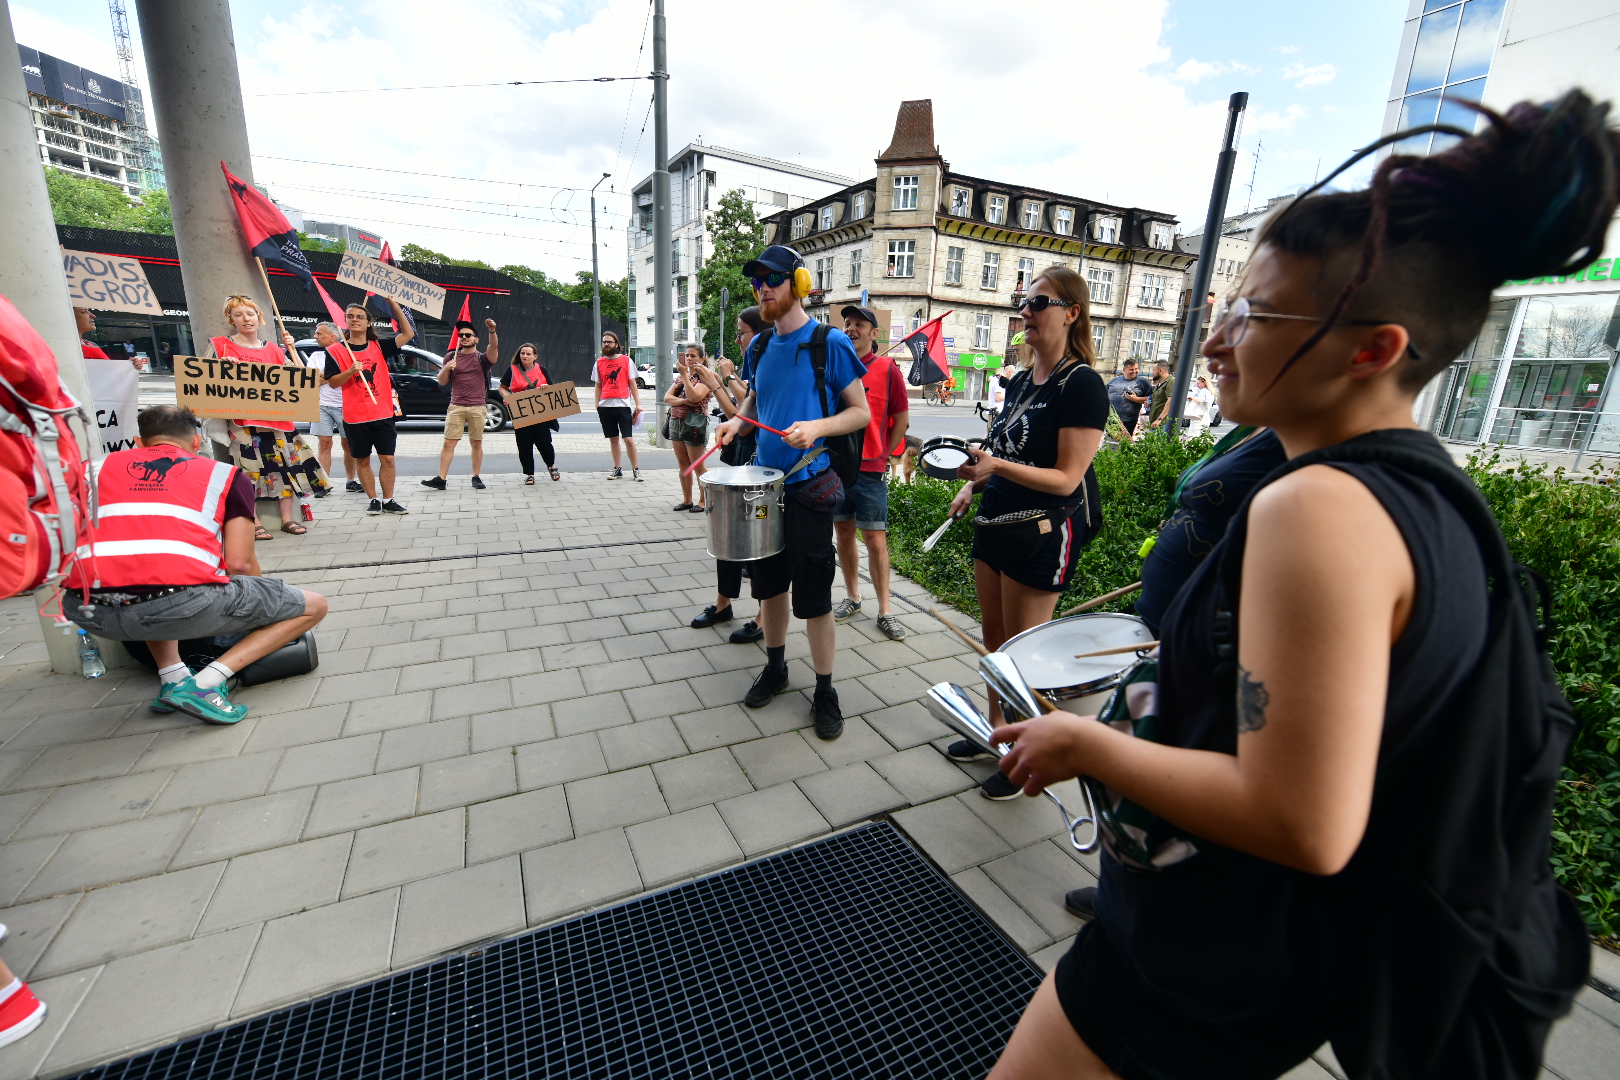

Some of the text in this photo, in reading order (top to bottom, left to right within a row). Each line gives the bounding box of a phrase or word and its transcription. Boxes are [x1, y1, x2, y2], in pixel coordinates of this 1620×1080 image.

[338, 266, 356, 280] NA
[358, 272, 398, 295] ALLEGRO
[183, 357, 316, 389] STRENGTH
[183, 383, 300, 403] IN NUMBERS
[507, 387, 579, 420] LET'S TALK
[103, 438, 135, 453] WY
